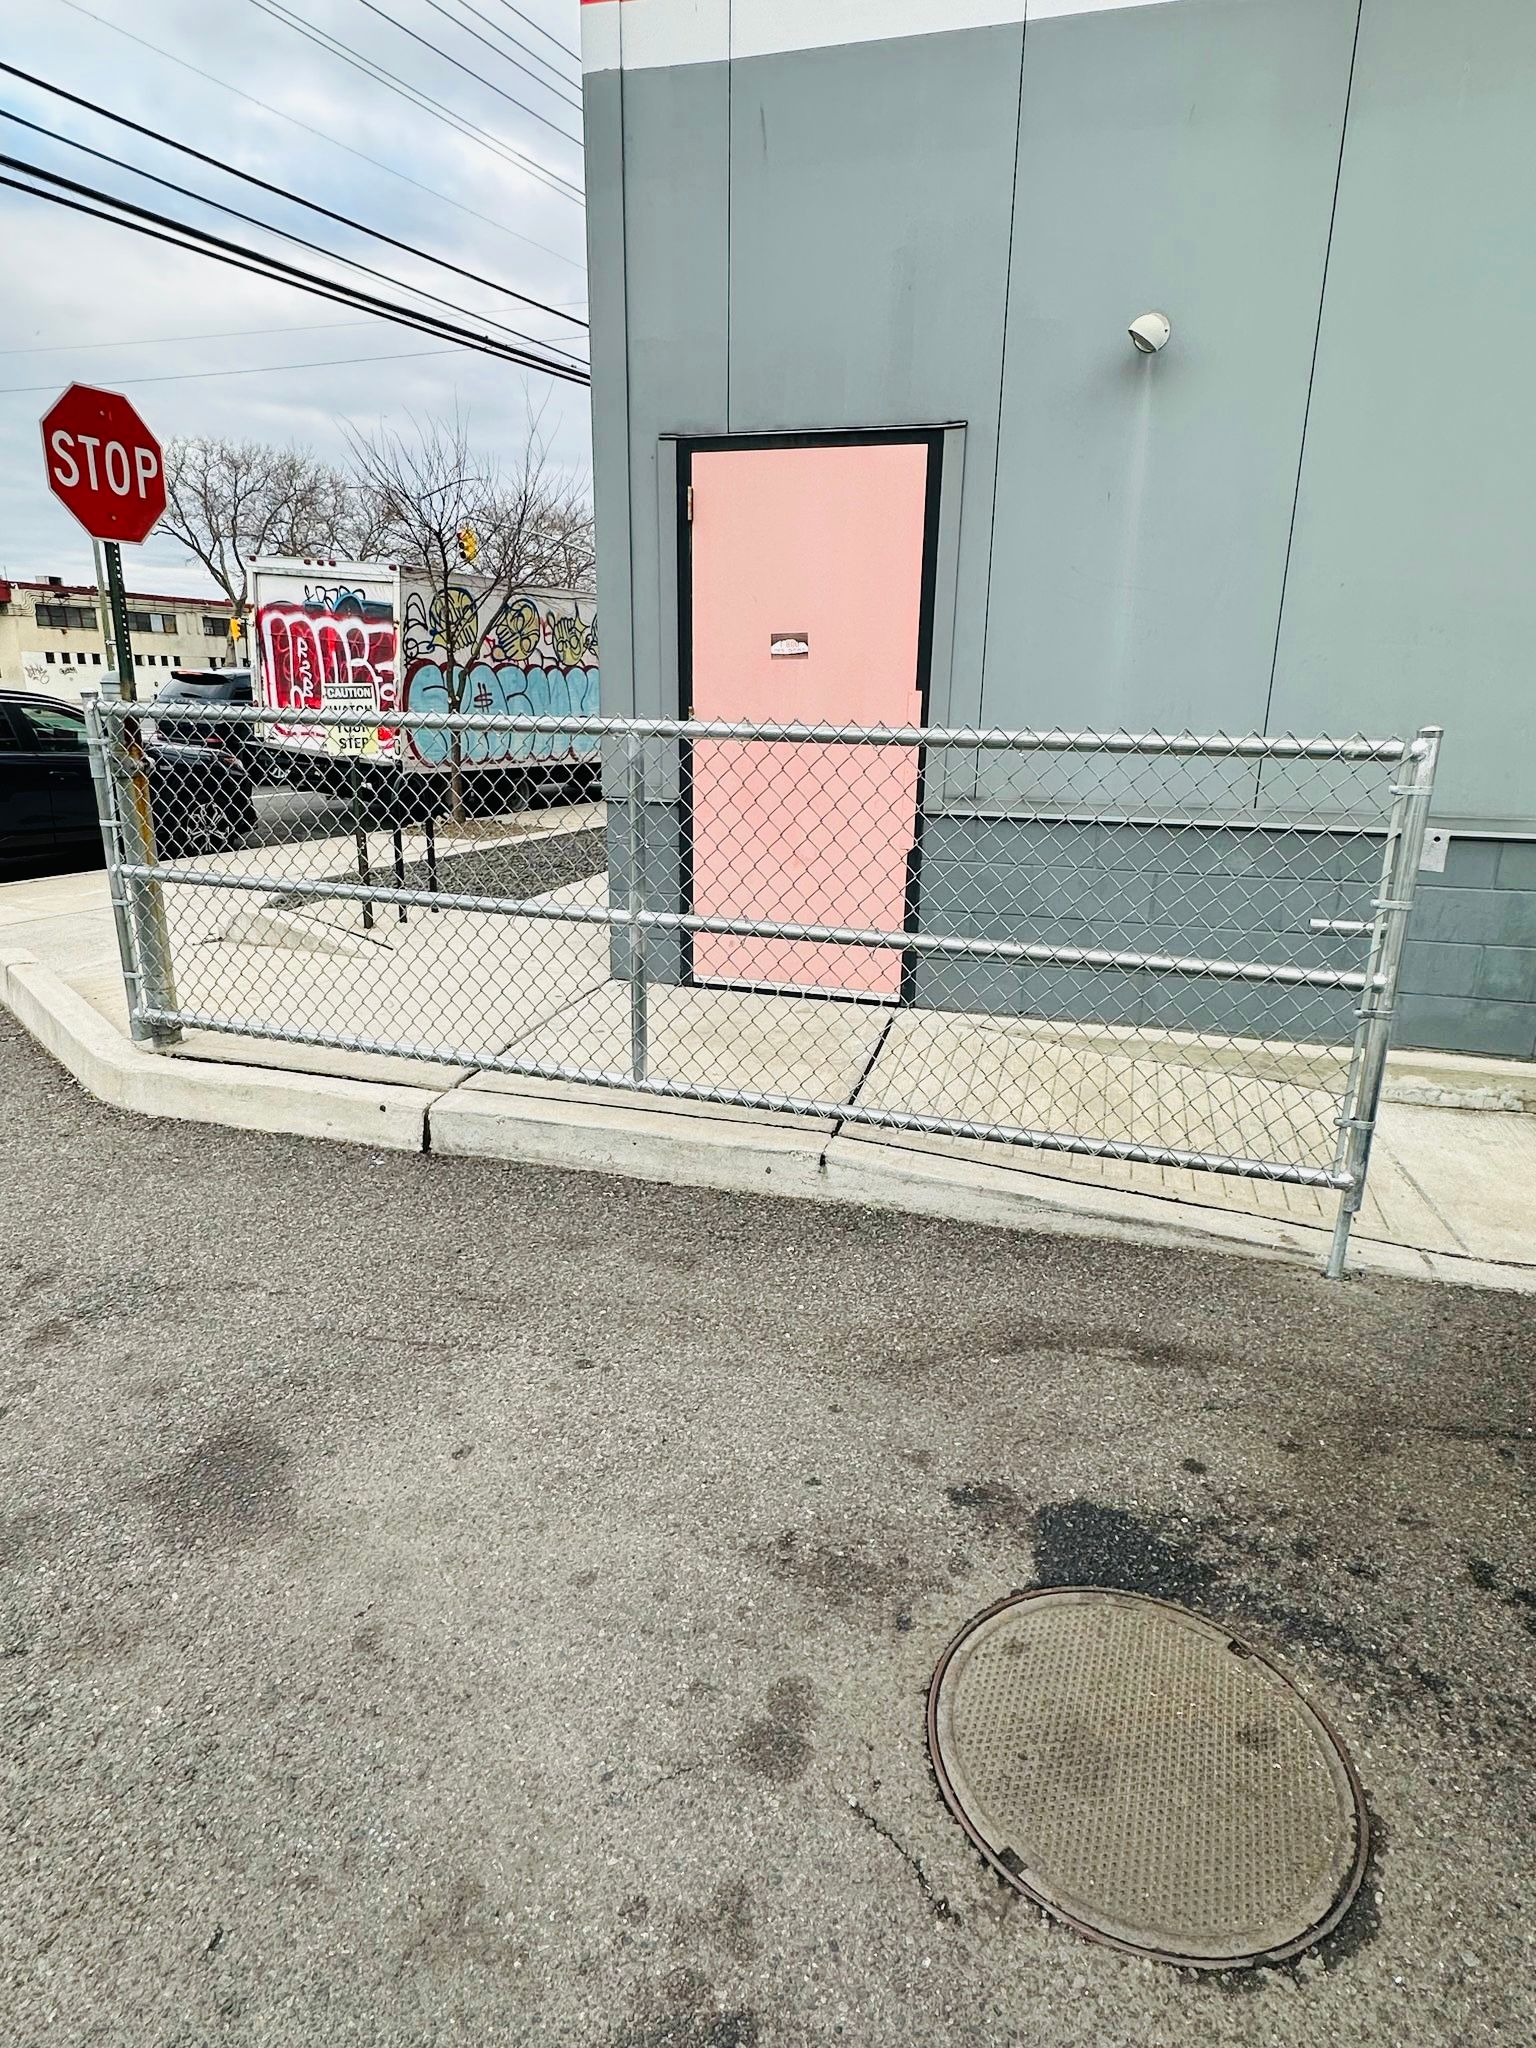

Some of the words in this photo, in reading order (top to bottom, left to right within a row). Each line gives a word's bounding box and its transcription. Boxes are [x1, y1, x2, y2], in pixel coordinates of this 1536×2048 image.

[51, 429, 158, 499] STOP
[326, 687, 372, 698] CAUTION
[339, 737, 369, 749] STEP
